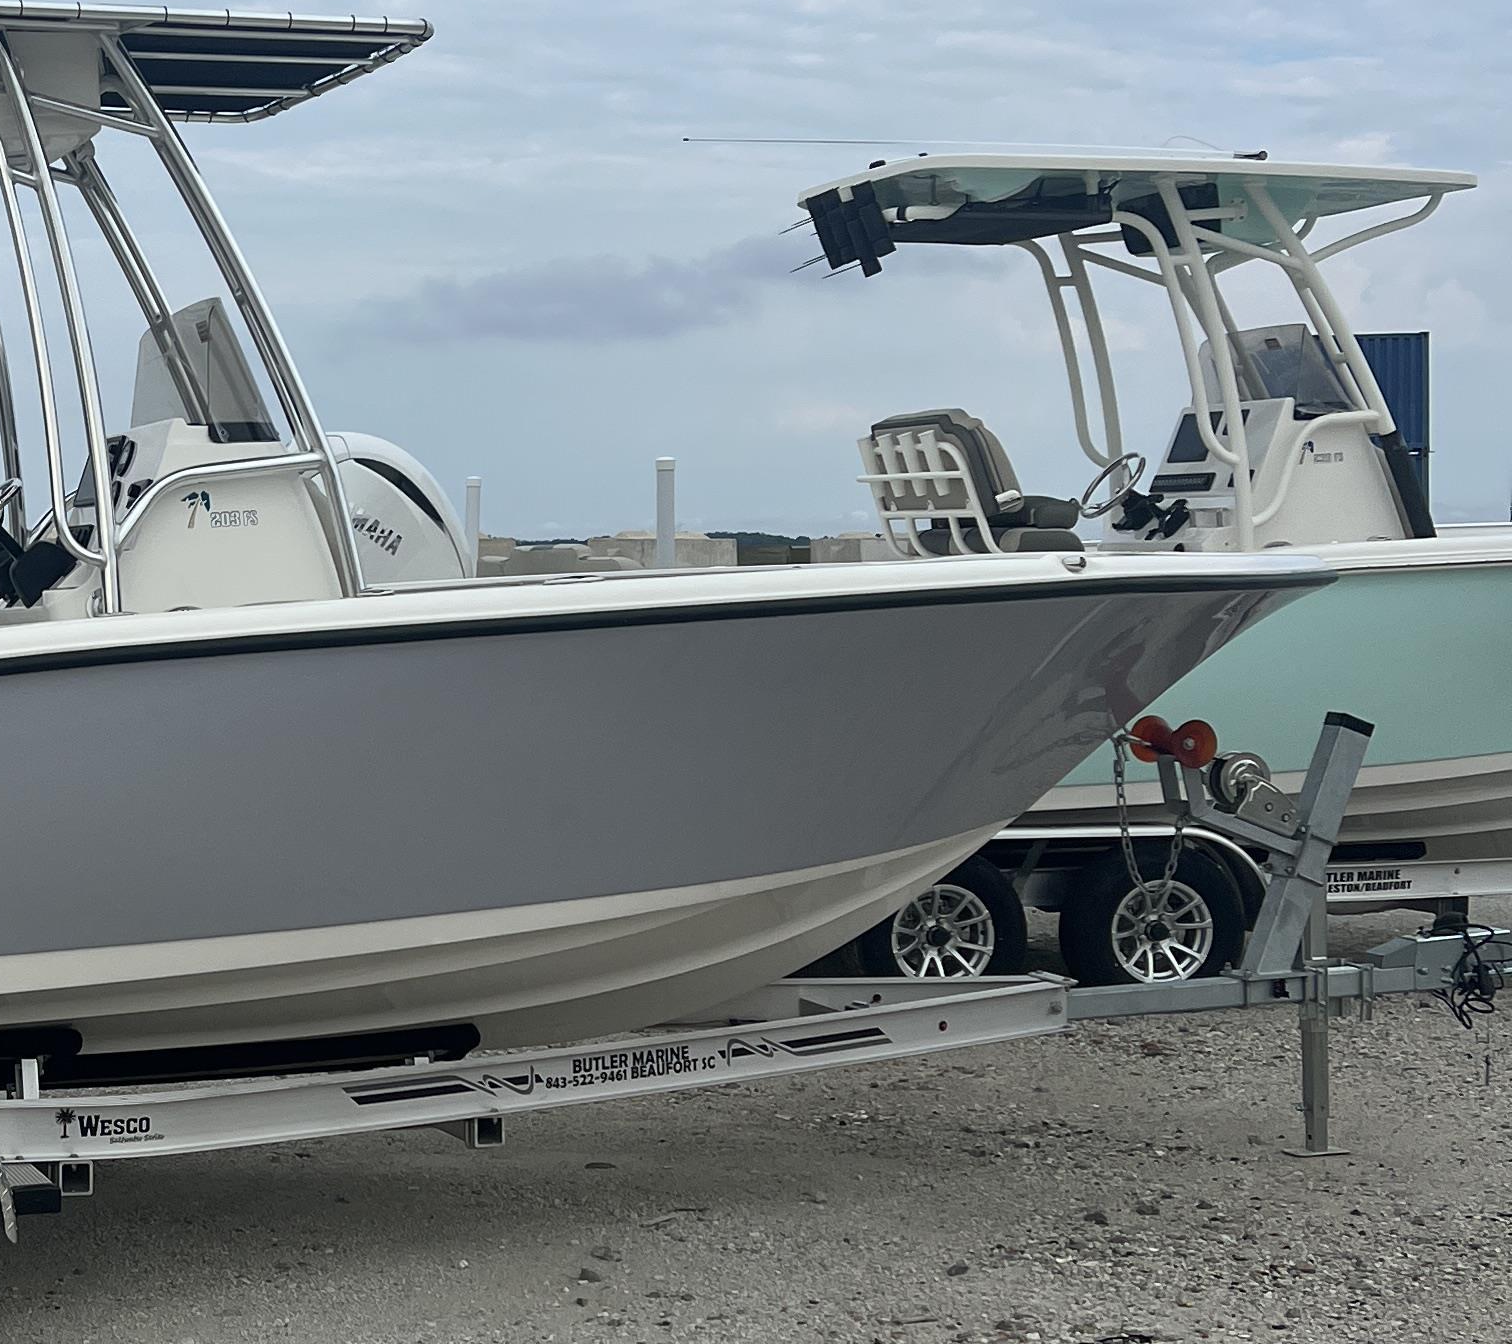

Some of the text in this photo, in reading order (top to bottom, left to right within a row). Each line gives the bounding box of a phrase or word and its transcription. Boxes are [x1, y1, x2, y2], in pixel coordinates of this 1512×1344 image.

[351, 509, 404, 556] MAHA
[1326, 869, 1401, 883] TLER MARINE
[1327, 880, 1413, 893] ESTON/BEAUFORT
[545, 1056, 716, 1089] 843-522-9461 BEAUFORT SC
[572, 1045, 689, 1074] BUTLER MARINE
